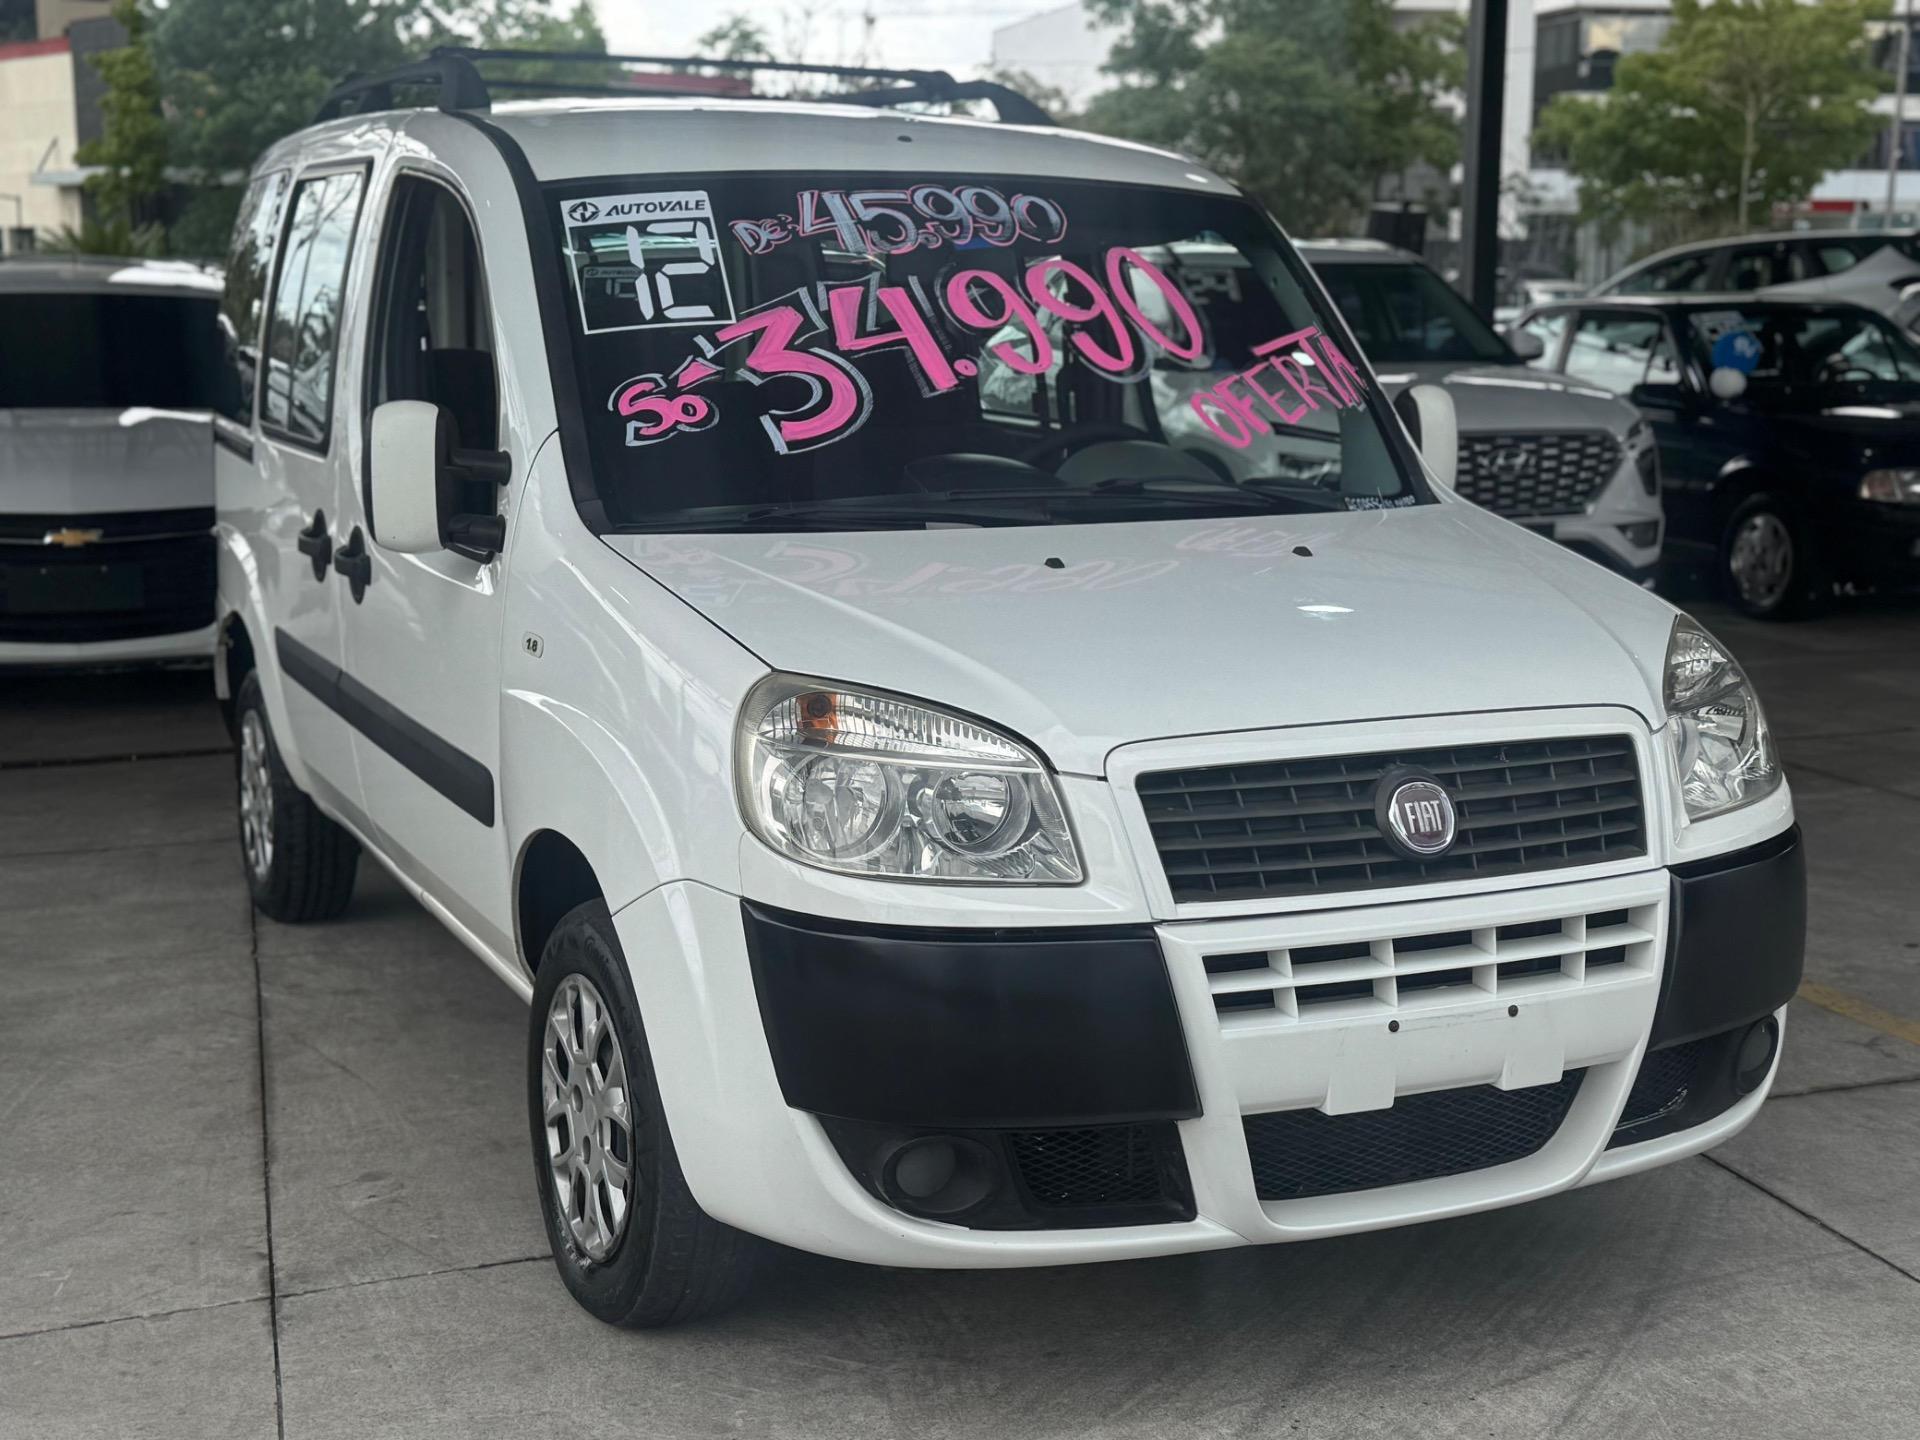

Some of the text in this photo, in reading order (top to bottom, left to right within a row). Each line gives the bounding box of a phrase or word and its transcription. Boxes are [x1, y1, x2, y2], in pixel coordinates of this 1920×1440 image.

[604, 199, 706, 217] AUTOVALE
[797, 184, 1067, 255] 45.990
[627, 220, 716, 321] 12
[706, 246, 1206, 448] 34.990
[1190, 325, 1367, 449] OFERTA
[1404, 800, 1443, 834] FIAT
